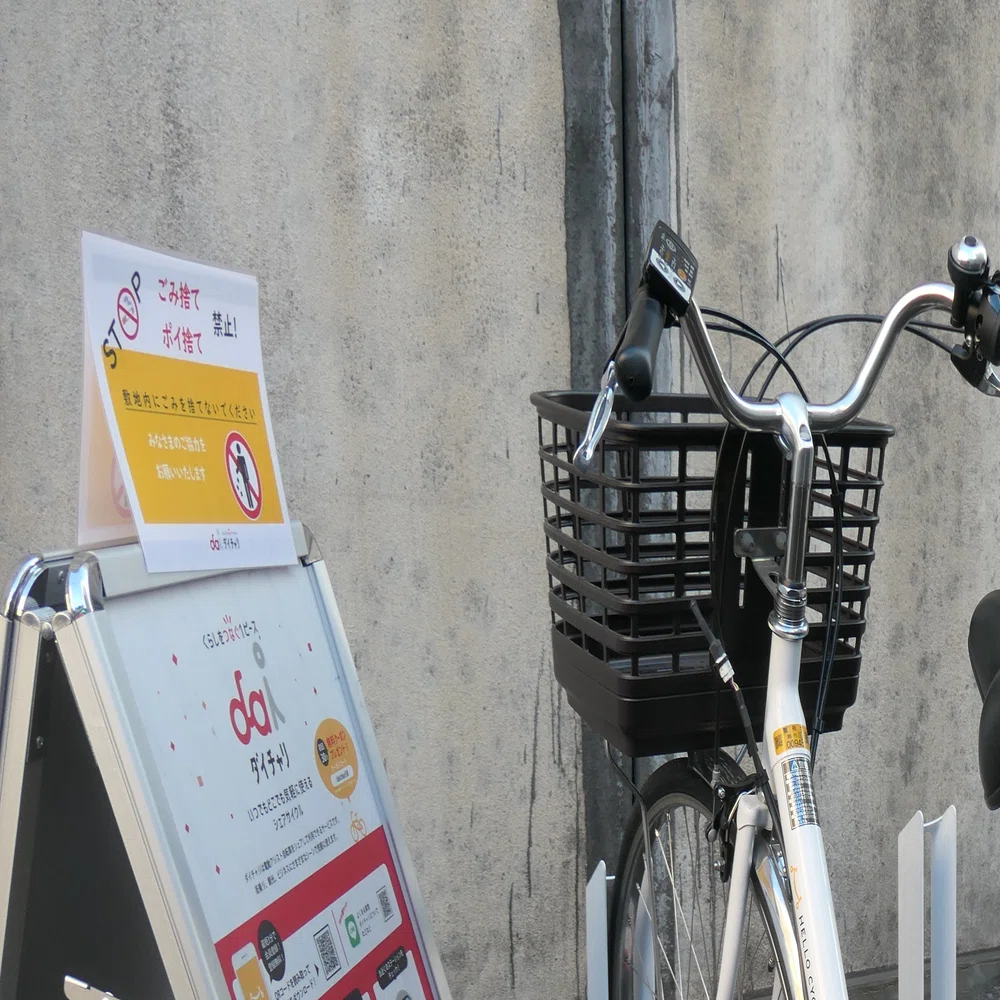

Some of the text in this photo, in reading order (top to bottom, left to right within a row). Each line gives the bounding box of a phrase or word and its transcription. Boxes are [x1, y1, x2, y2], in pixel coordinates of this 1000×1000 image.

[158, 278, 200, 310] ごみ捨て
[162, 322, 203, 354] ポイ捨て
[122, 389, 256, 420] 敷地内にごみを捨てないでください
[250, 742, 290, 784] ダイチャリ
[247, 776, 313, 822] いつでもどこでも気軽に使える
[273, 804, 304, 831] シェアサイクル
[799, 914, 811, 970] HELLO
